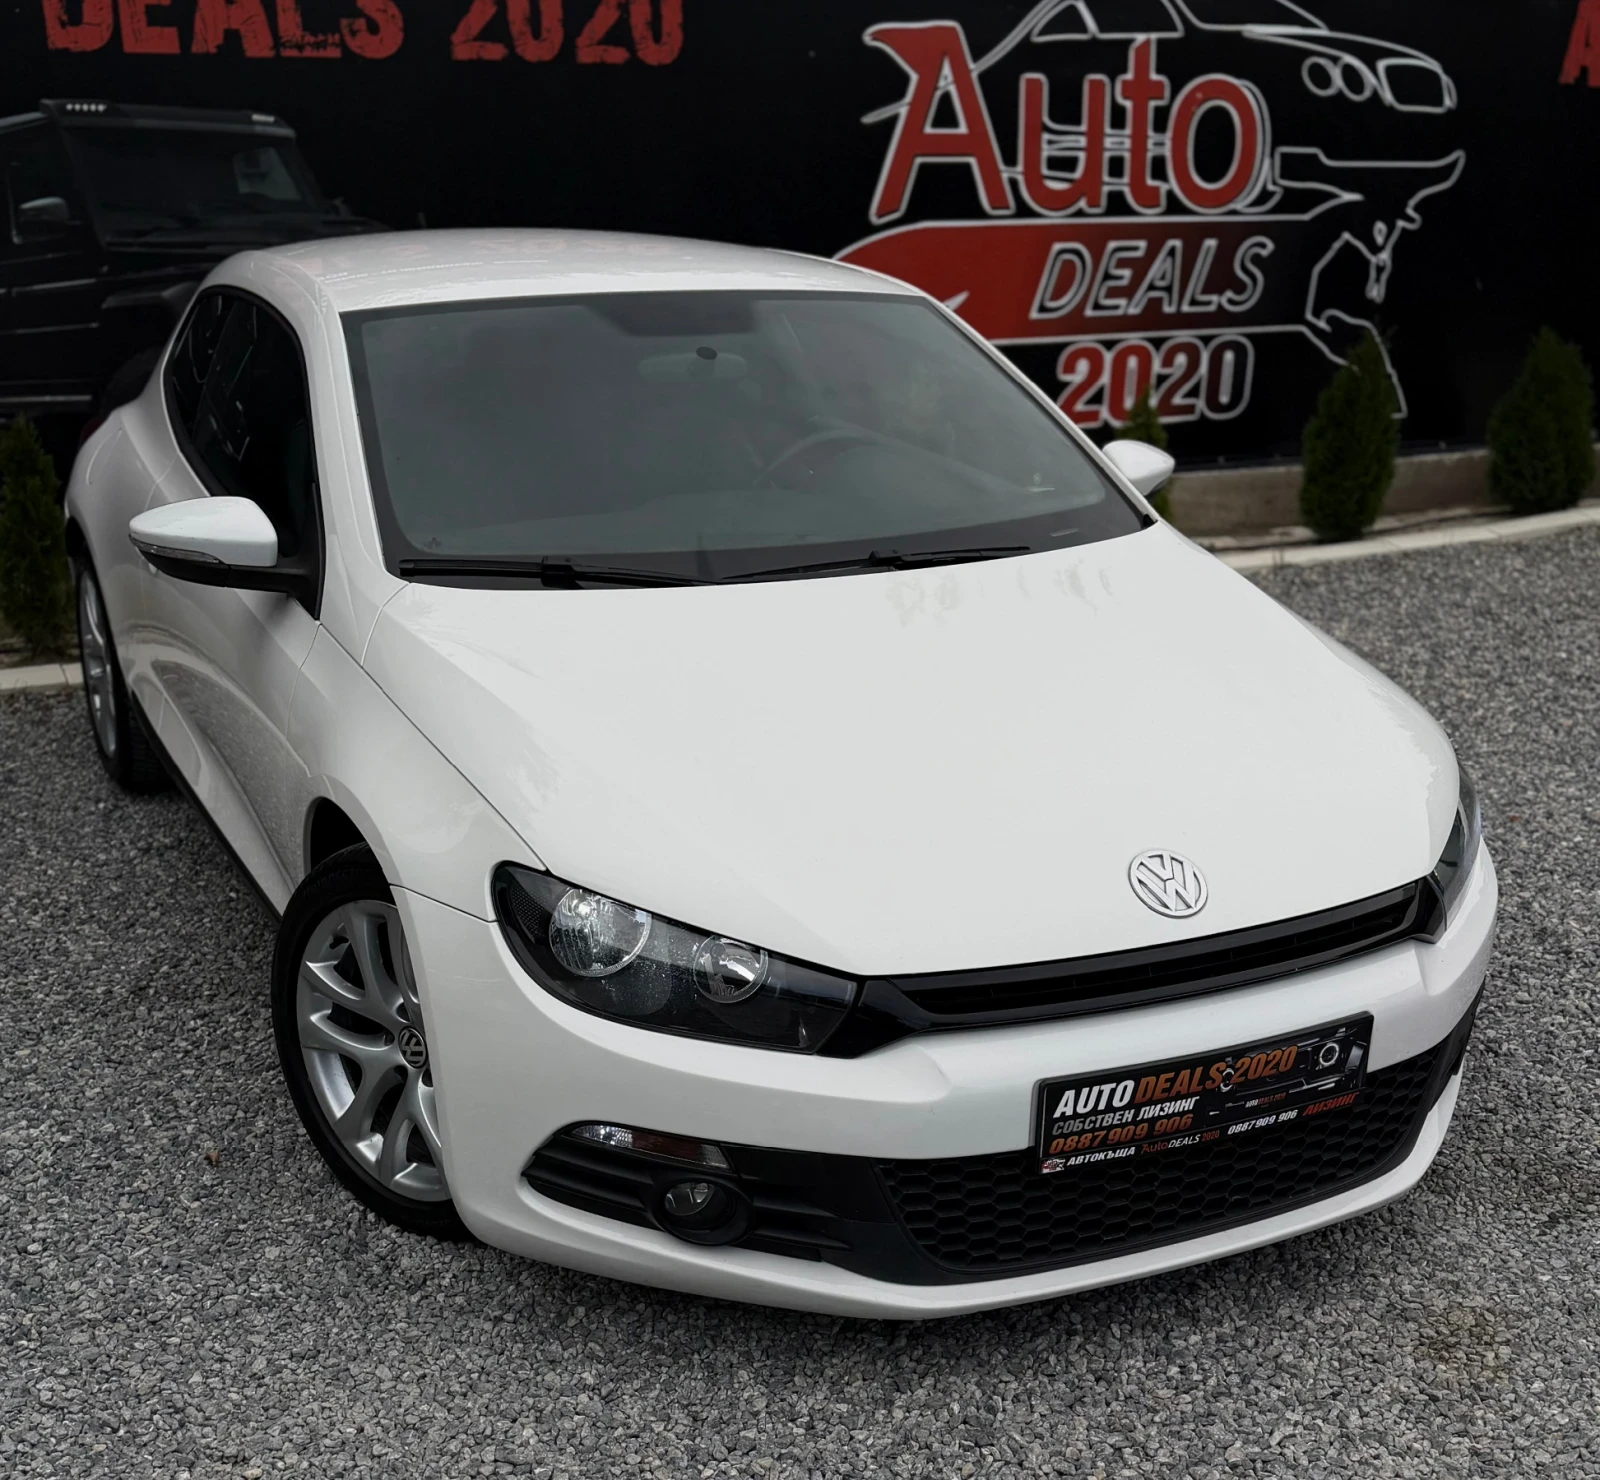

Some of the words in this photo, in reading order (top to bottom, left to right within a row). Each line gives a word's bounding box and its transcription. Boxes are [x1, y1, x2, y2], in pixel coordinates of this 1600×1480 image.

[862, 21, 1266, 224] Auto
[1030, 236, 1275, 319] DEALS
[1056, 334, 1255, 429] 2020
[1052, 1109, 1134, 1136] СОБСТВЕН
[1137, 1096, 1200, 1121] ЛИЗИНГ
[1053, 1080, 1135, 1118] AUTO
[1133, 1062, 1227, 1104] DEALS
[1230, 1045, 1299, 1084] 2020
[1202, 1130, 1220, 1142] 2020
[1277, 1110, 1298, 1123] 906
[1302, 1092, 1360, 1117] ЛИЗИНГ
[1153, 1113, 1194, 1136] 906
